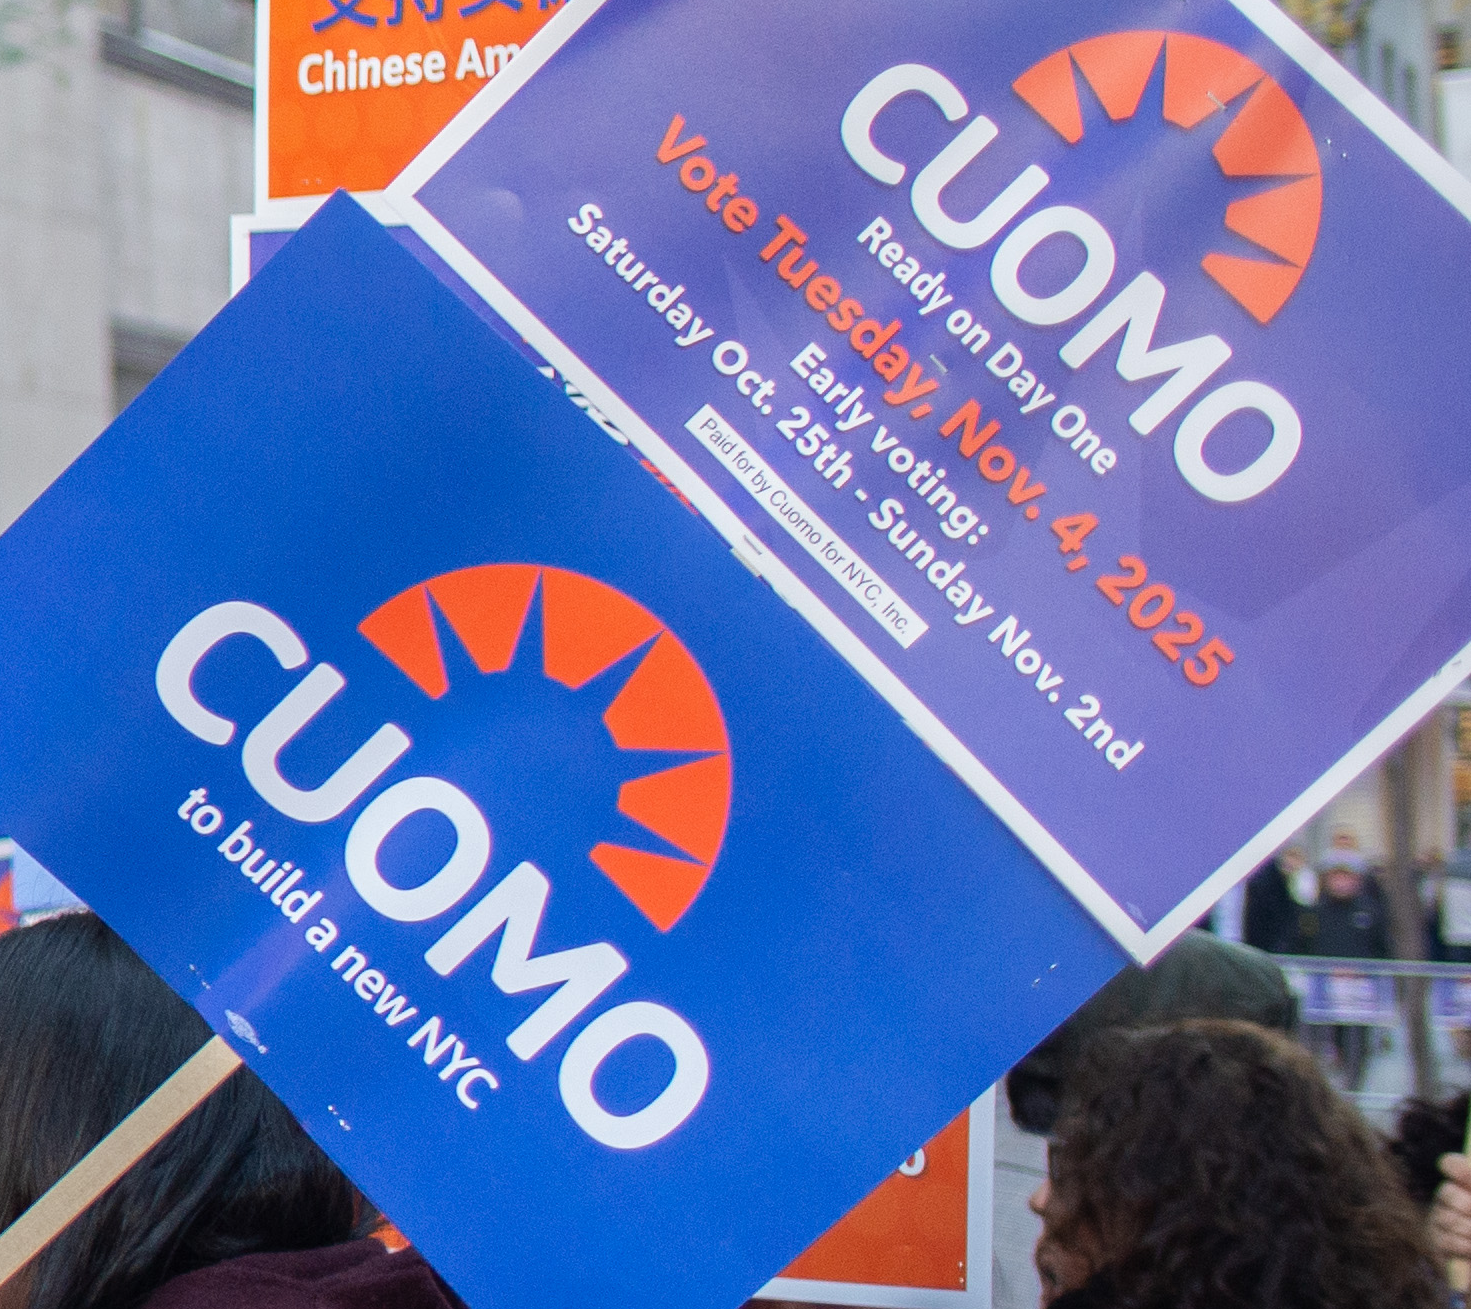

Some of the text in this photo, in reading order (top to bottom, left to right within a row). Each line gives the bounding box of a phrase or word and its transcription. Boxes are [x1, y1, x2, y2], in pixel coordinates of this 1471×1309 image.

[298, 48, 446, 96] Chinese
[657, 114, 1234, 686] Vote Tuesday, Nov. 4, 2025
[790, 342, 988, 545] Early voting:
[842, 64, 1301, 502] CUOMO
[858, 217, 1116, 474] Ready on Day One
[568, 203, 714, 346] Saturday
[713, 341, 775, 414] Oct.
[776, 406, 852, 488] 25th
[869, 499, 994, 625] Sunday
[989, 615, 1063, 691] Nov.
[1064, 695, 1144, 770] 2nd
[699, 417, 908, 634] Paid for by Cuomo for NYC, Inc.
[156, 601, 710, 1150] CUOMO
[178, 788, 499, 1110] to build a new NYC
